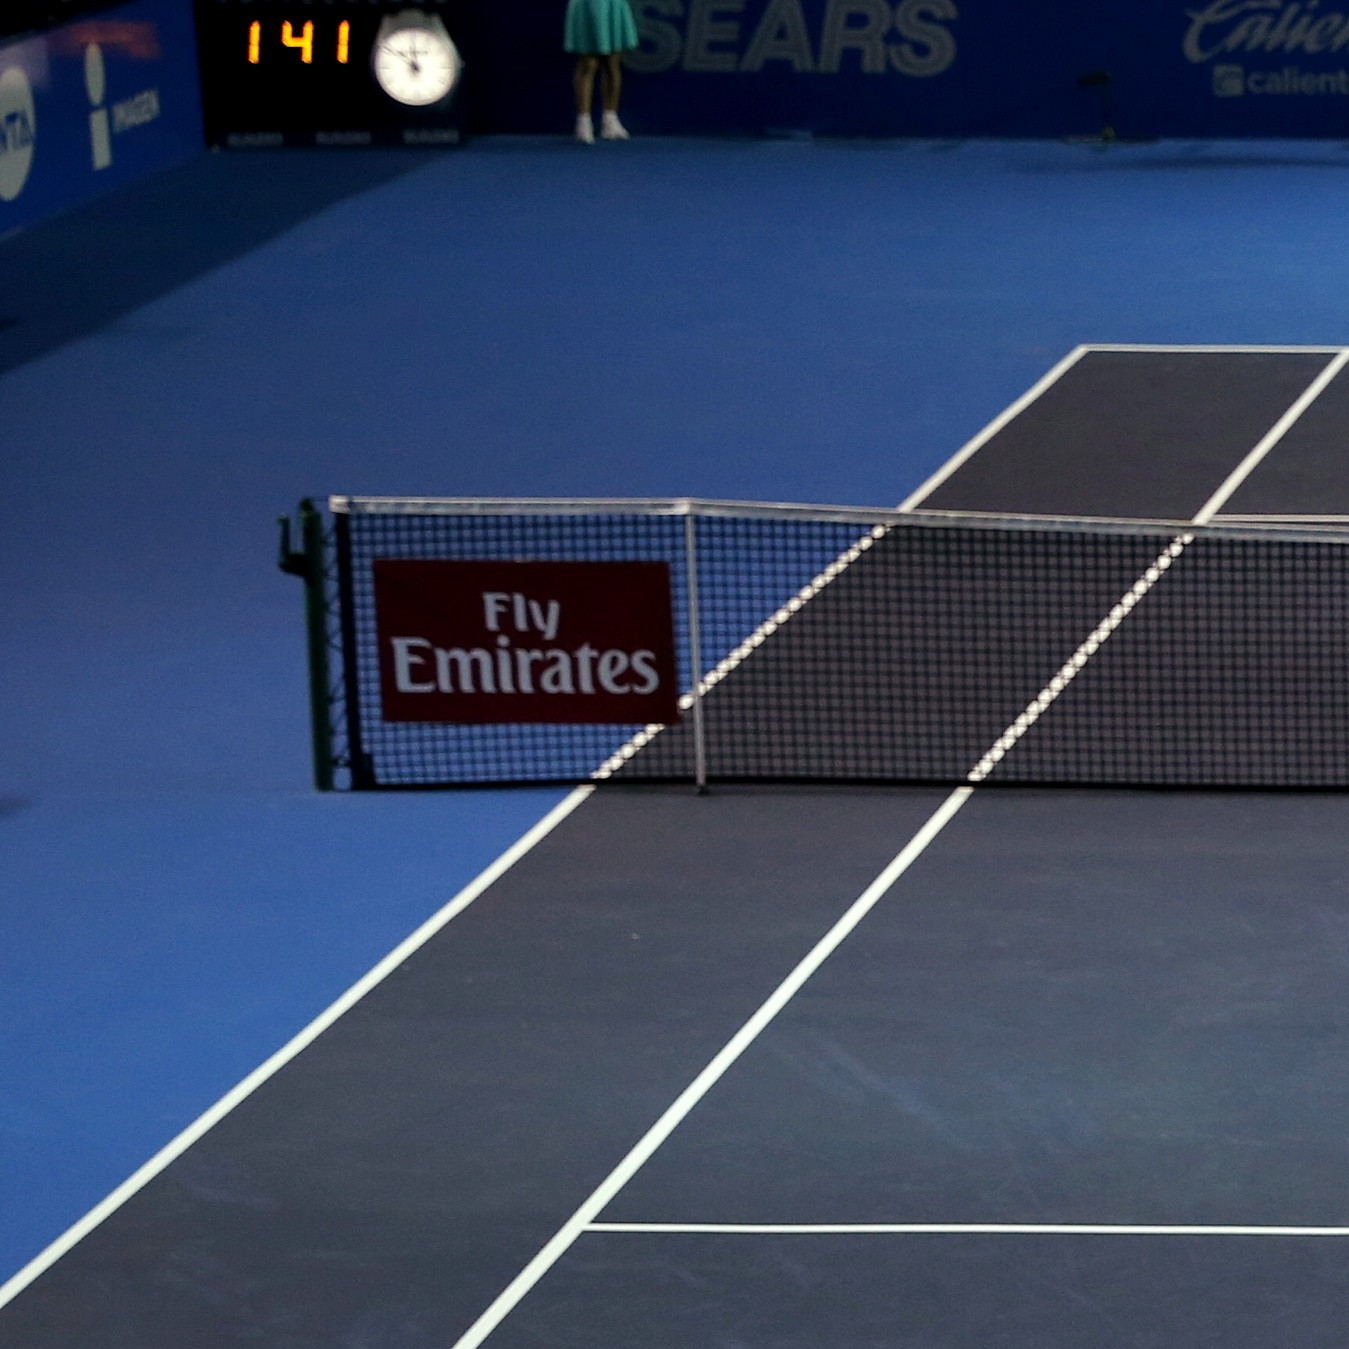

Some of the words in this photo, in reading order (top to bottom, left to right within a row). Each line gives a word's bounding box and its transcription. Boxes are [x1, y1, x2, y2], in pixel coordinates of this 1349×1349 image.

[621, 0, 958, 77] SEARS
[482, 591, 561, 641] Fly
[390, 634, 660, 694] Emirates
